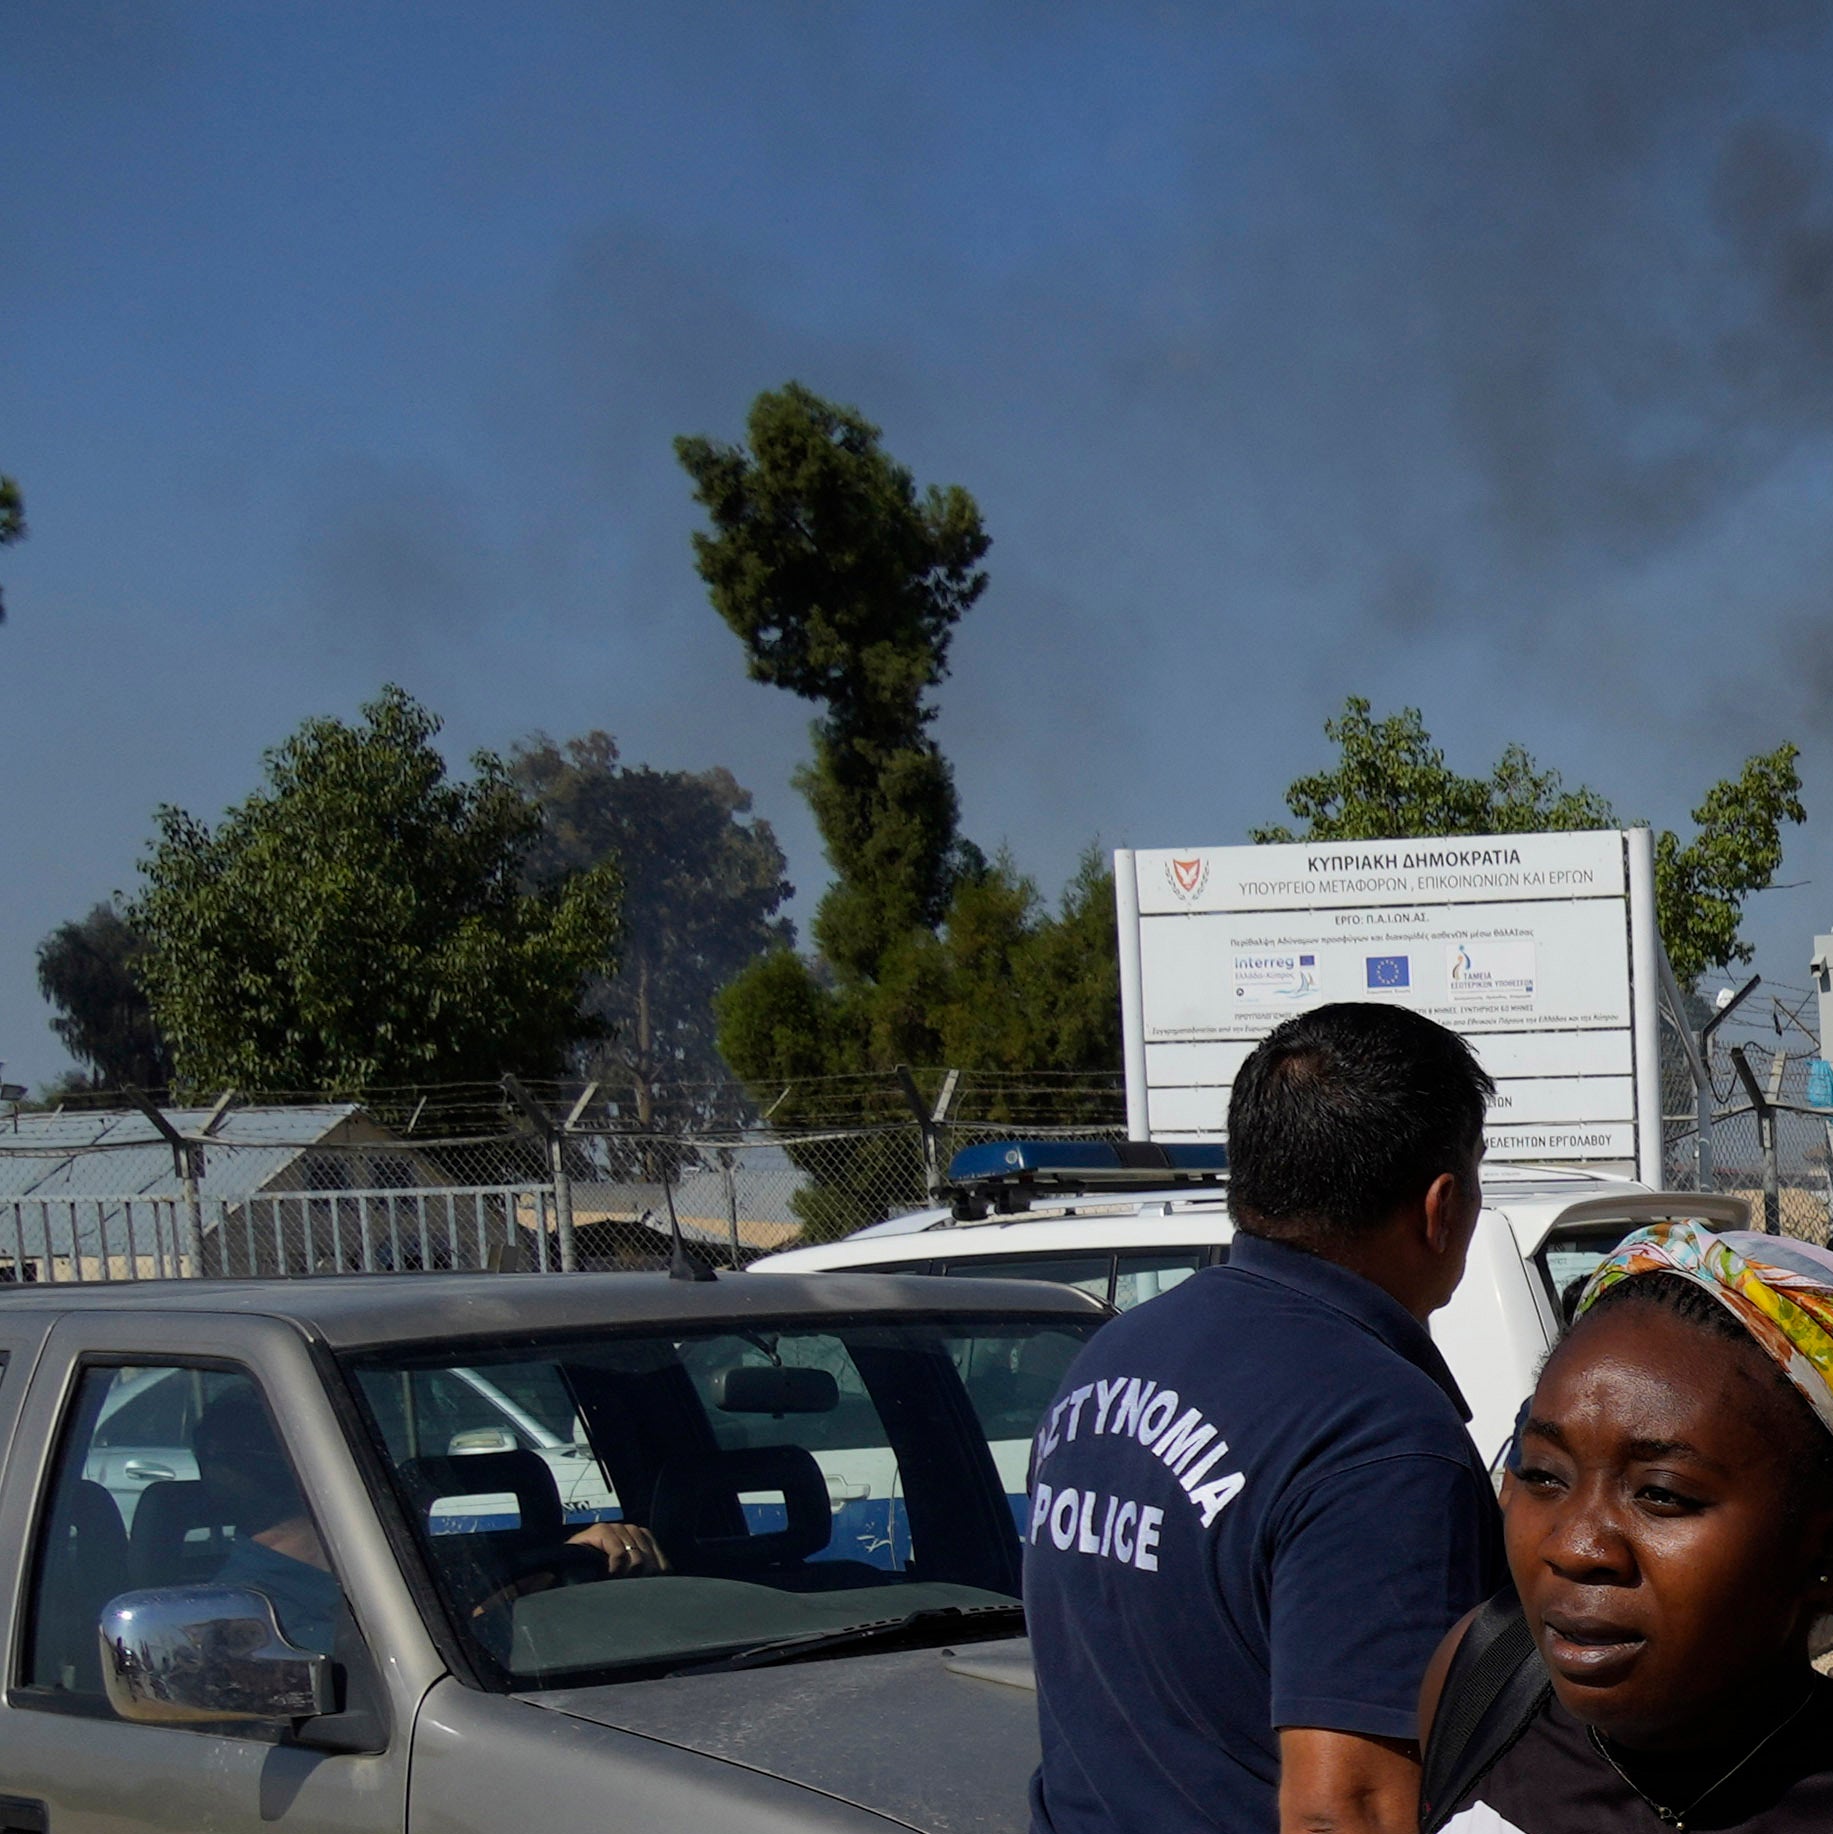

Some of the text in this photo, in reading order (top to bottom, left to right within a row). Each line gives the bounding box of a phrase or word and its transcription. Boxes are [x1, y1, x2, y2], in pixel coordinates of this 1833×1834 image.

[1307, 849, 1521, 873] ΚΥΠΡΙΑΚΗ ΔΗΜΟΚΡΑΤΙΑ
[1238, 880, 1316, 896] ΥΠΟΥΡΓΕΙΟ
[1318, 877, 1408, 894] ΜΕΤΑΦΟΡΩΝ
[1417, 872, 1520, 890] ΕΠΙΚΟΙΝΩΝΙΩΝ
[1523, 871, 1546, 886] ΚΑΙ
[1549, 869, 1594, 885] ΕΡΓΩΝ
[1334, 914, 1364, 926] ΕΡΓΟ:
[1234, 956, 1295, 970] Interreg
[1549, 1134, 1613, 1148] ΕΡΓΟΛΑΒΟΥ
[1030, 1482, 1165, 1572] POLICE
